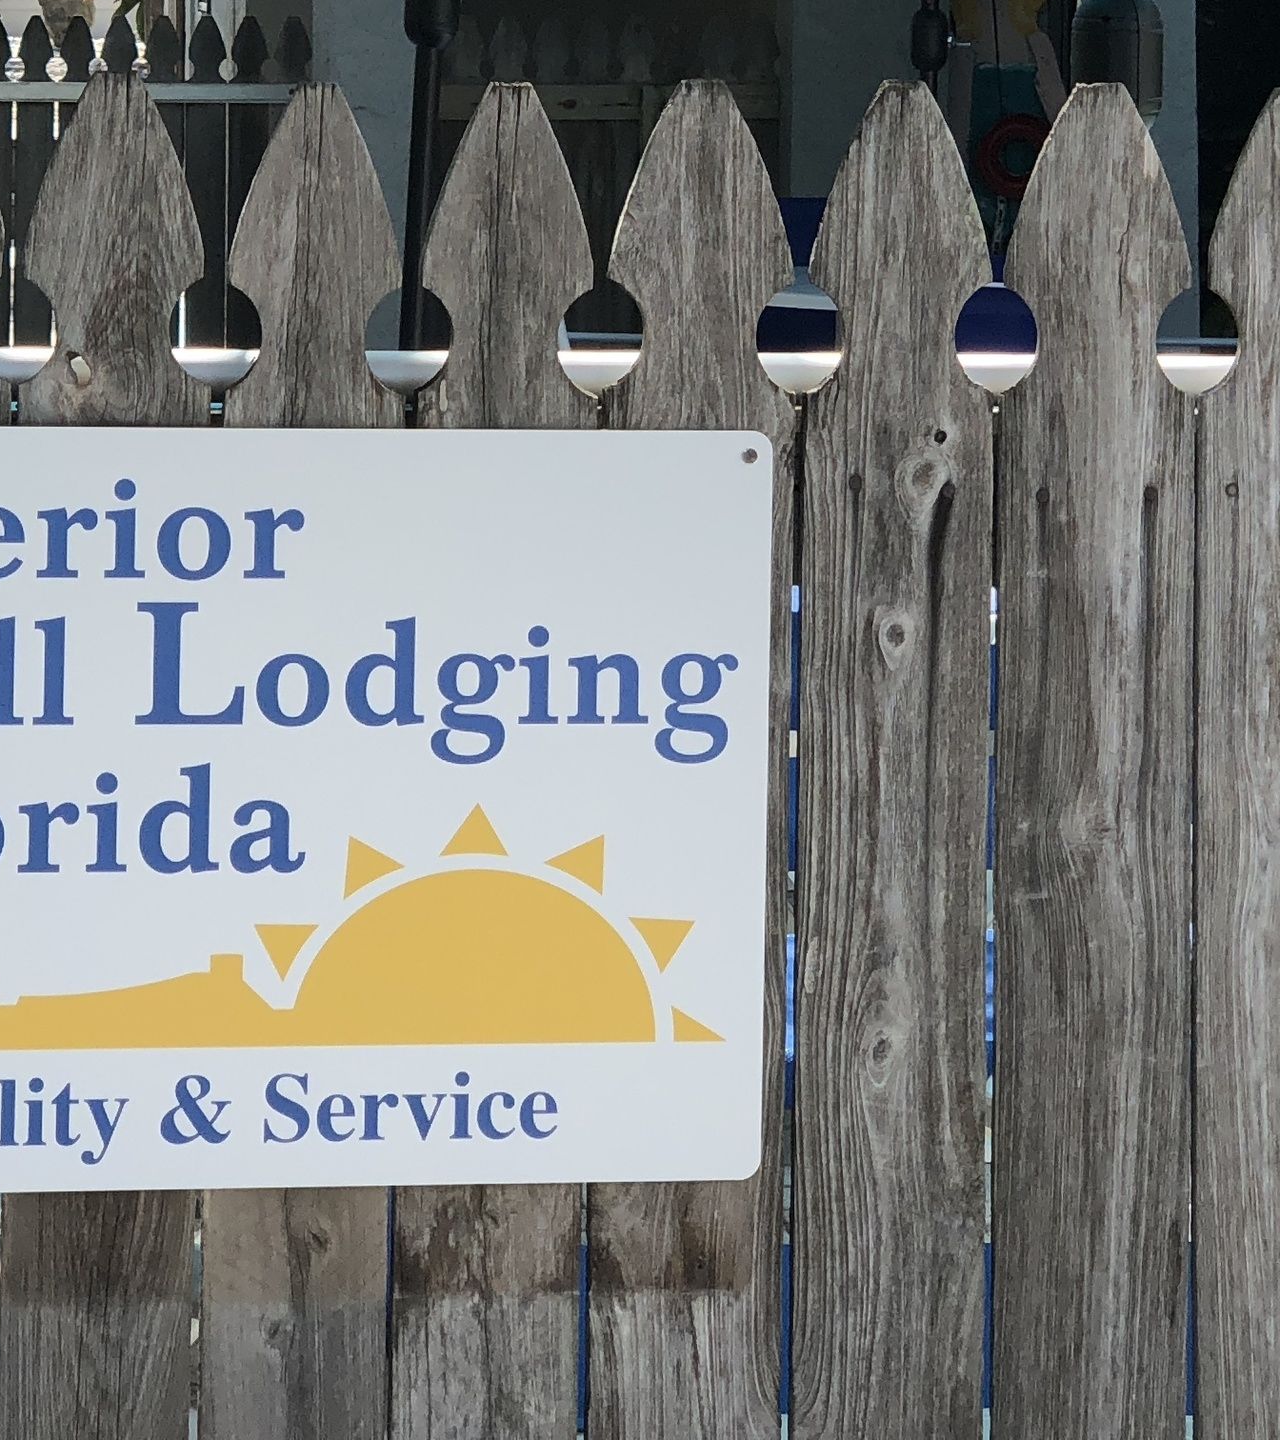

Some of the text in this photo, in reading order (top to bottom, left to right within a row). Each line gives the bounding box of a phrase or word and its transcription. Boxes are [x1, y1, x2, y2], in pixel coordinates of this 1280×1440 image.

[135, 601, 739, 765] Lodging
[159, 1075, 232, 1147] &
[263, 1071, 560, 1144] Service
